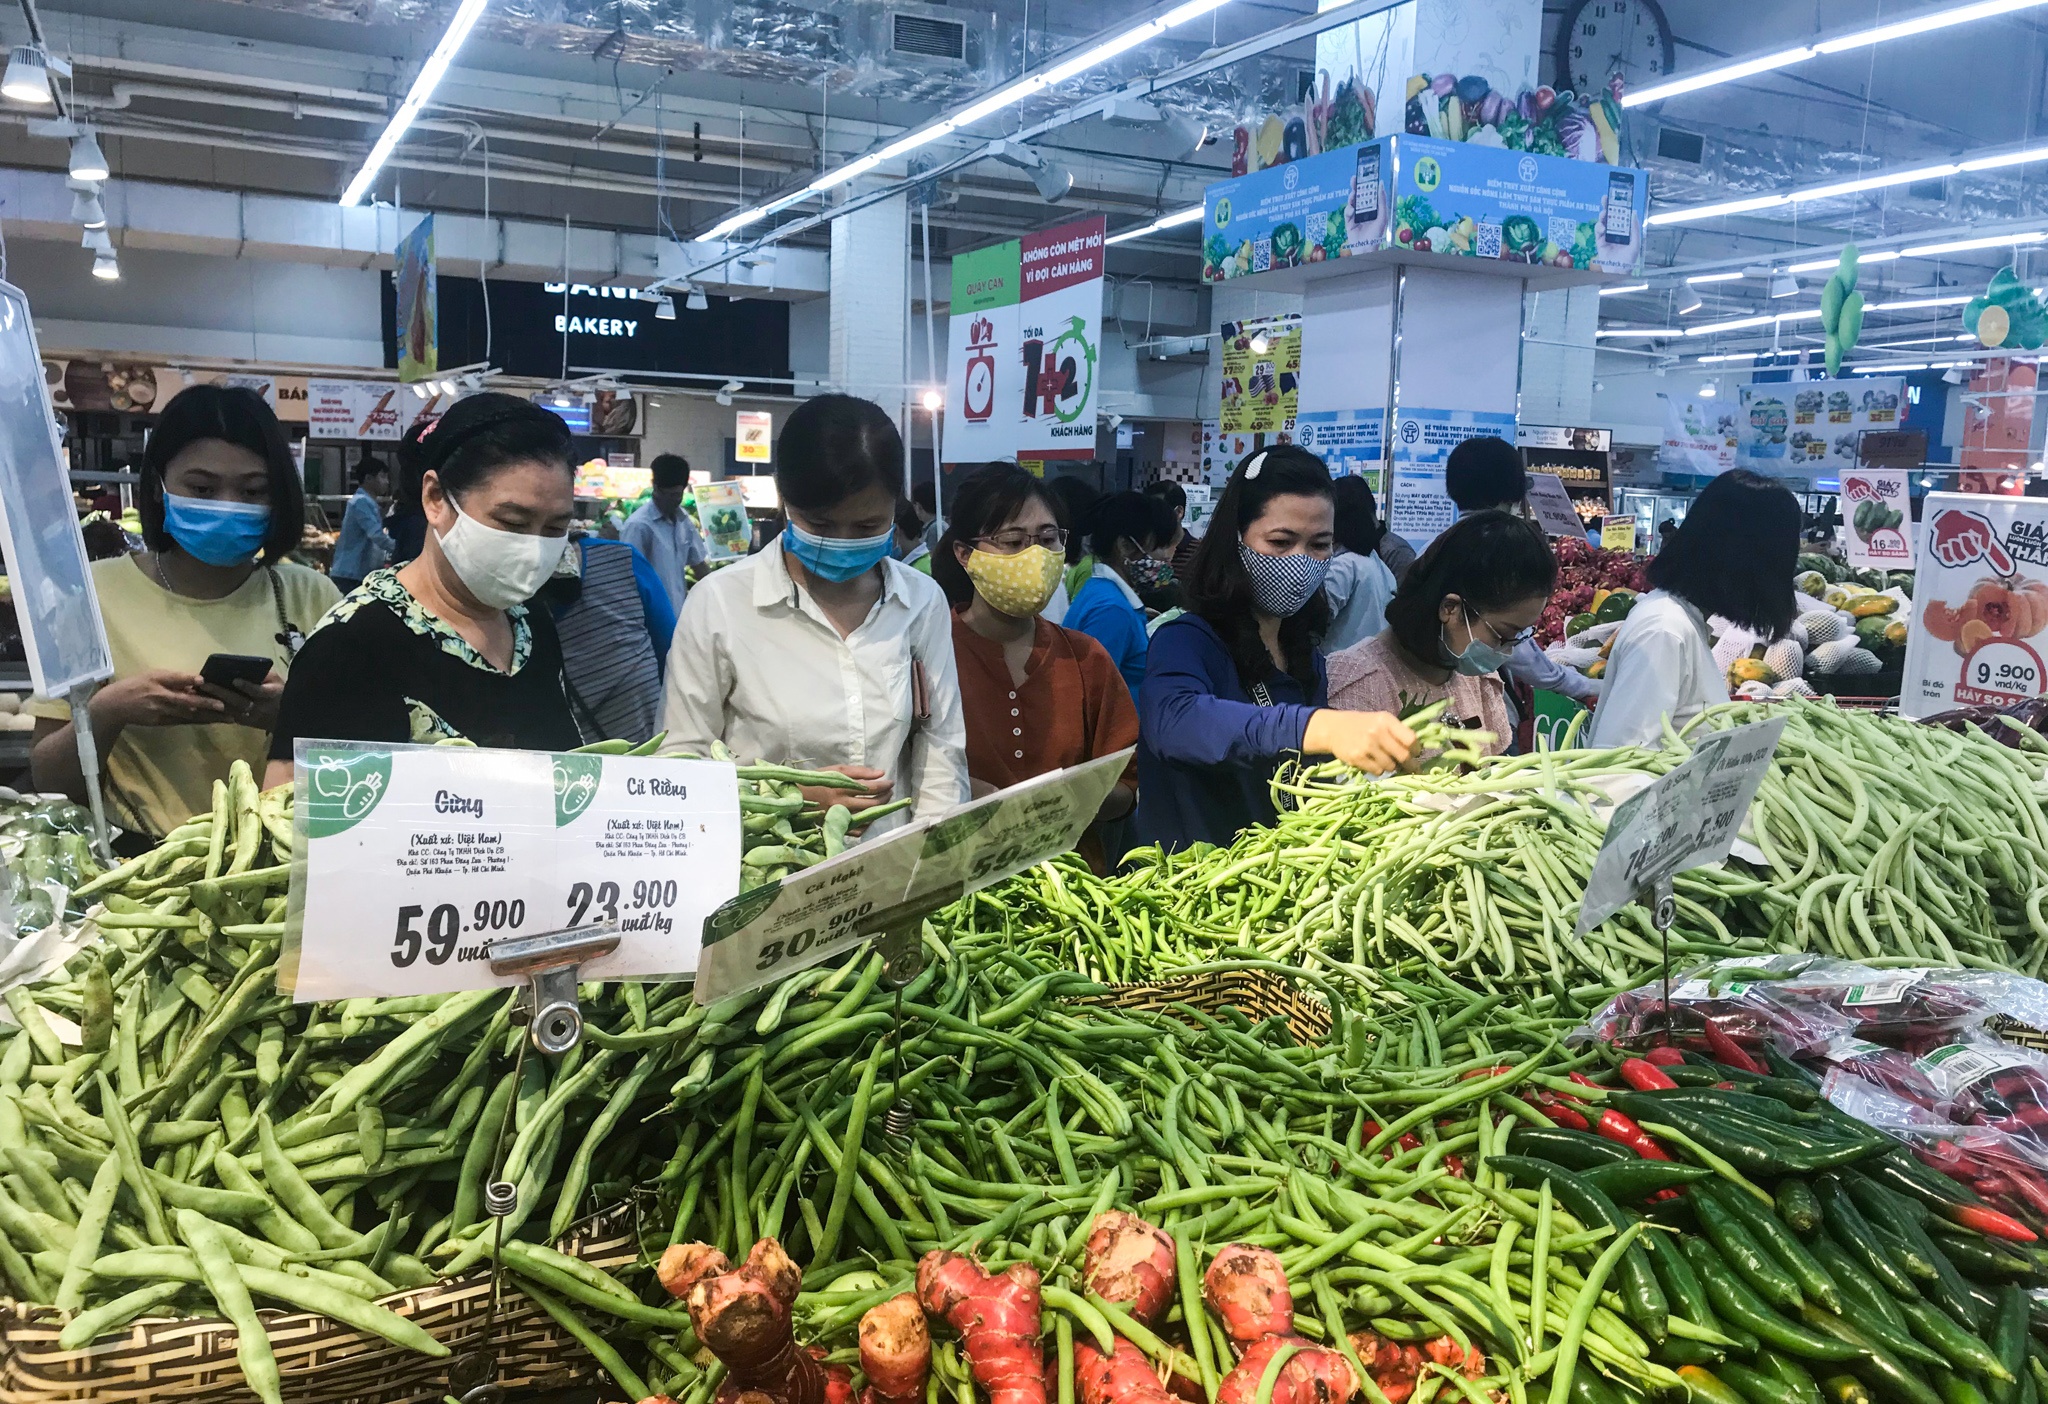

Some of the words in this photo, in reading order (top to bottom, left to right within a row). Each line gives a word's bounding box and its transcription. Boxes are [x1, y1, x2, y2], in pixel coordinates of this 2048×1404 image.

[1595, 6, 1606, 18] 11
[1614, 2, 1626, 13] 12
[1583, 23, 1596, 36] 10
[1647, 34, 1654, 47] 2
[1575, 46, 1582, 58] 9
[1650, 60, 1657, 72] 3
[1023, 246, 1049, 263] KHÔNG
[1050, 242, 1067, 257] CÒN
[1067, 236, 1085, 254] MỆT
[1026, 268, 1034, 283] VÌ
[1035, 270, 1049, 283] ĐỢI
[1051, 263, 1068, 278] CÂN
[1069, 258, 1093, 274] HÀNG
[555, 315, 637, 337] BAKERY
[1256, 365, 1264, 375] 29
[1051, 425, 1073, 437] KHÁCH
[1074, 425, 1093, 436] HÀNG
[1284, 420, 1295, 430] 29
[1873, 540, 1886, 549] 16
[1978, 663, 1990, 684] 9
[1995, 664, 2035, 681] .900
[1922, 679, 1931, 687] Bí
[1995, 680, 2027, 692] vnd/Kg
[1984, 694, 2005, 706] SO
[626, 777, 646, 796] Củ
[649, 778, 687, 800] Riềng
[607, 819, 630, 831] (Xuất
[647, 819, 661, 832] Việt
[664, 819, 683, 831] Nam)
[411, 833, 438, 847] (Xuất
[458, 833, 475, 847] Việt
[478, 832, 502, 845] Nam)
[621, 911, 674, 934] vnđ/kg
